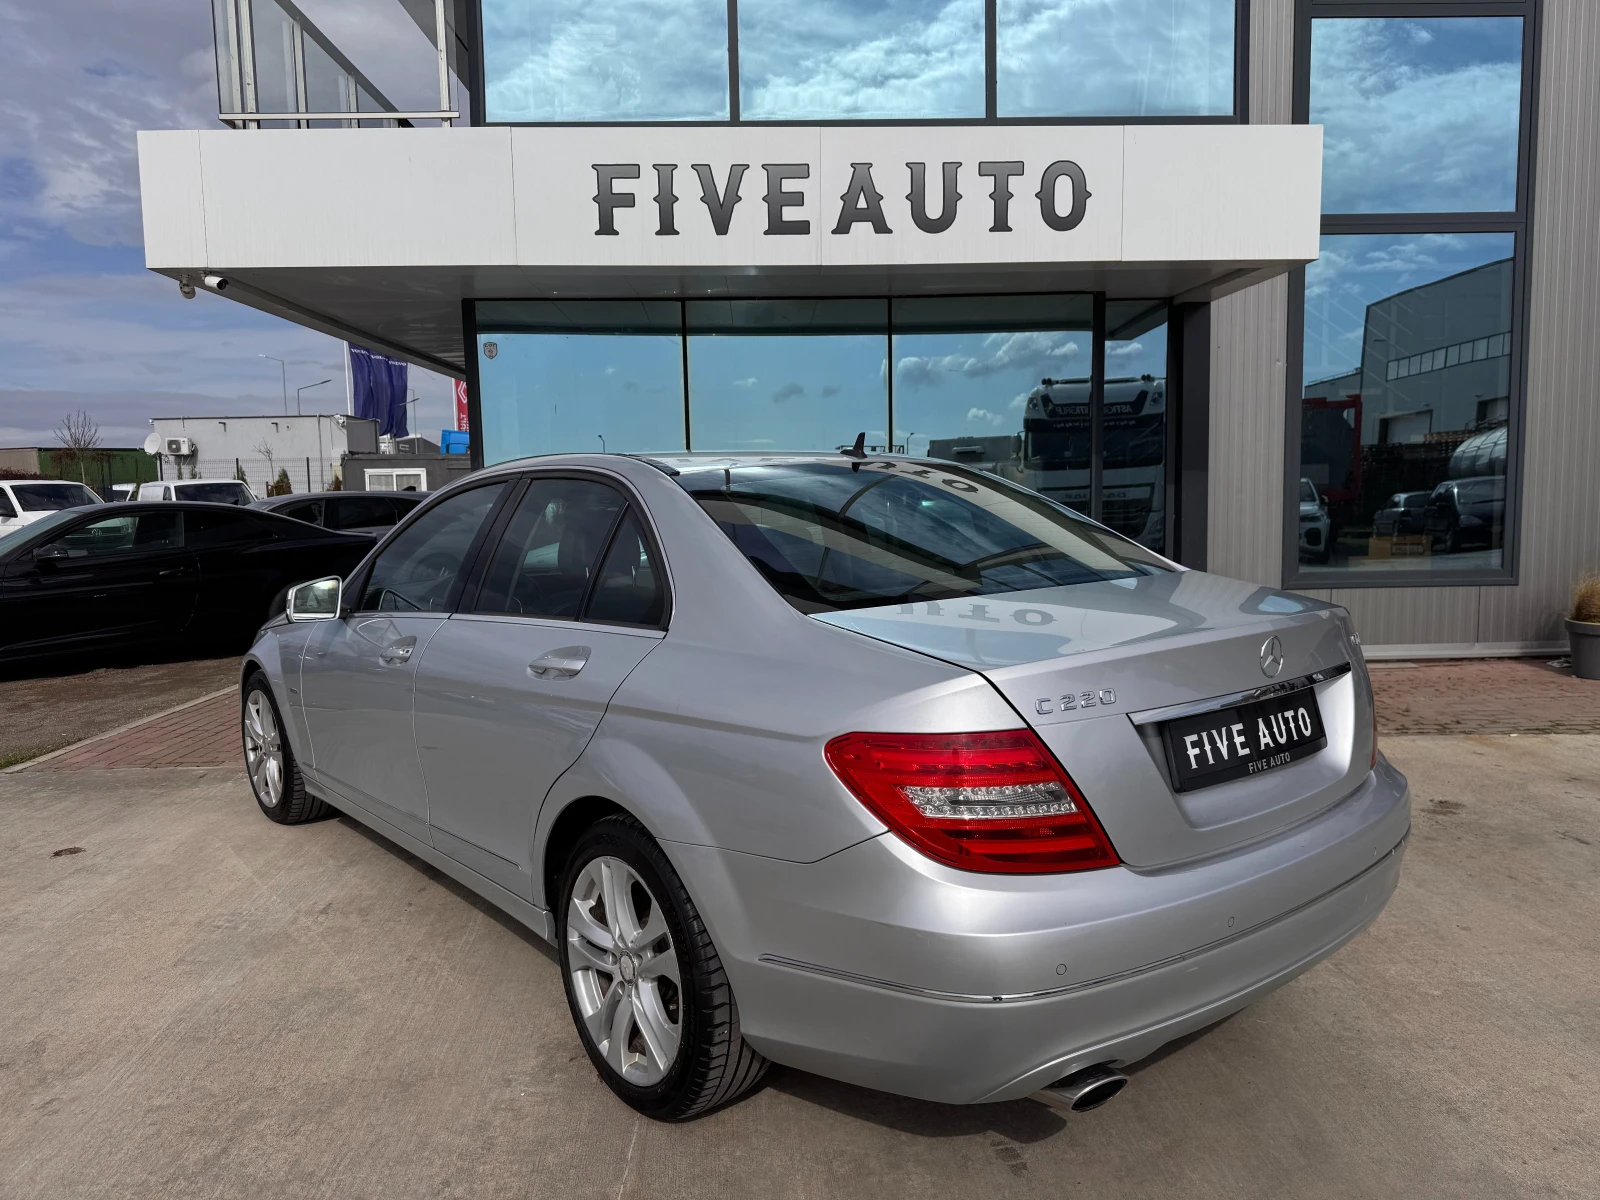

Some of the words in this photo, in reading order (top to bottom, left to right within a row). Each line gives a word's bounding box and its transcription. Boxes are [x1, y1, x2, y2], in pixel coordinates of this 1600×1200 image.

[1035, 698, 1053, 715] C
[1059, 688, 1116, 711] 220
[1183, 723, 1250, 769] FIVE
[1257, 707, 1312, 750] AUTO
[1248, 759, 1268, 774] FIVE
[1270, 752, 1291, 767] AUTO
